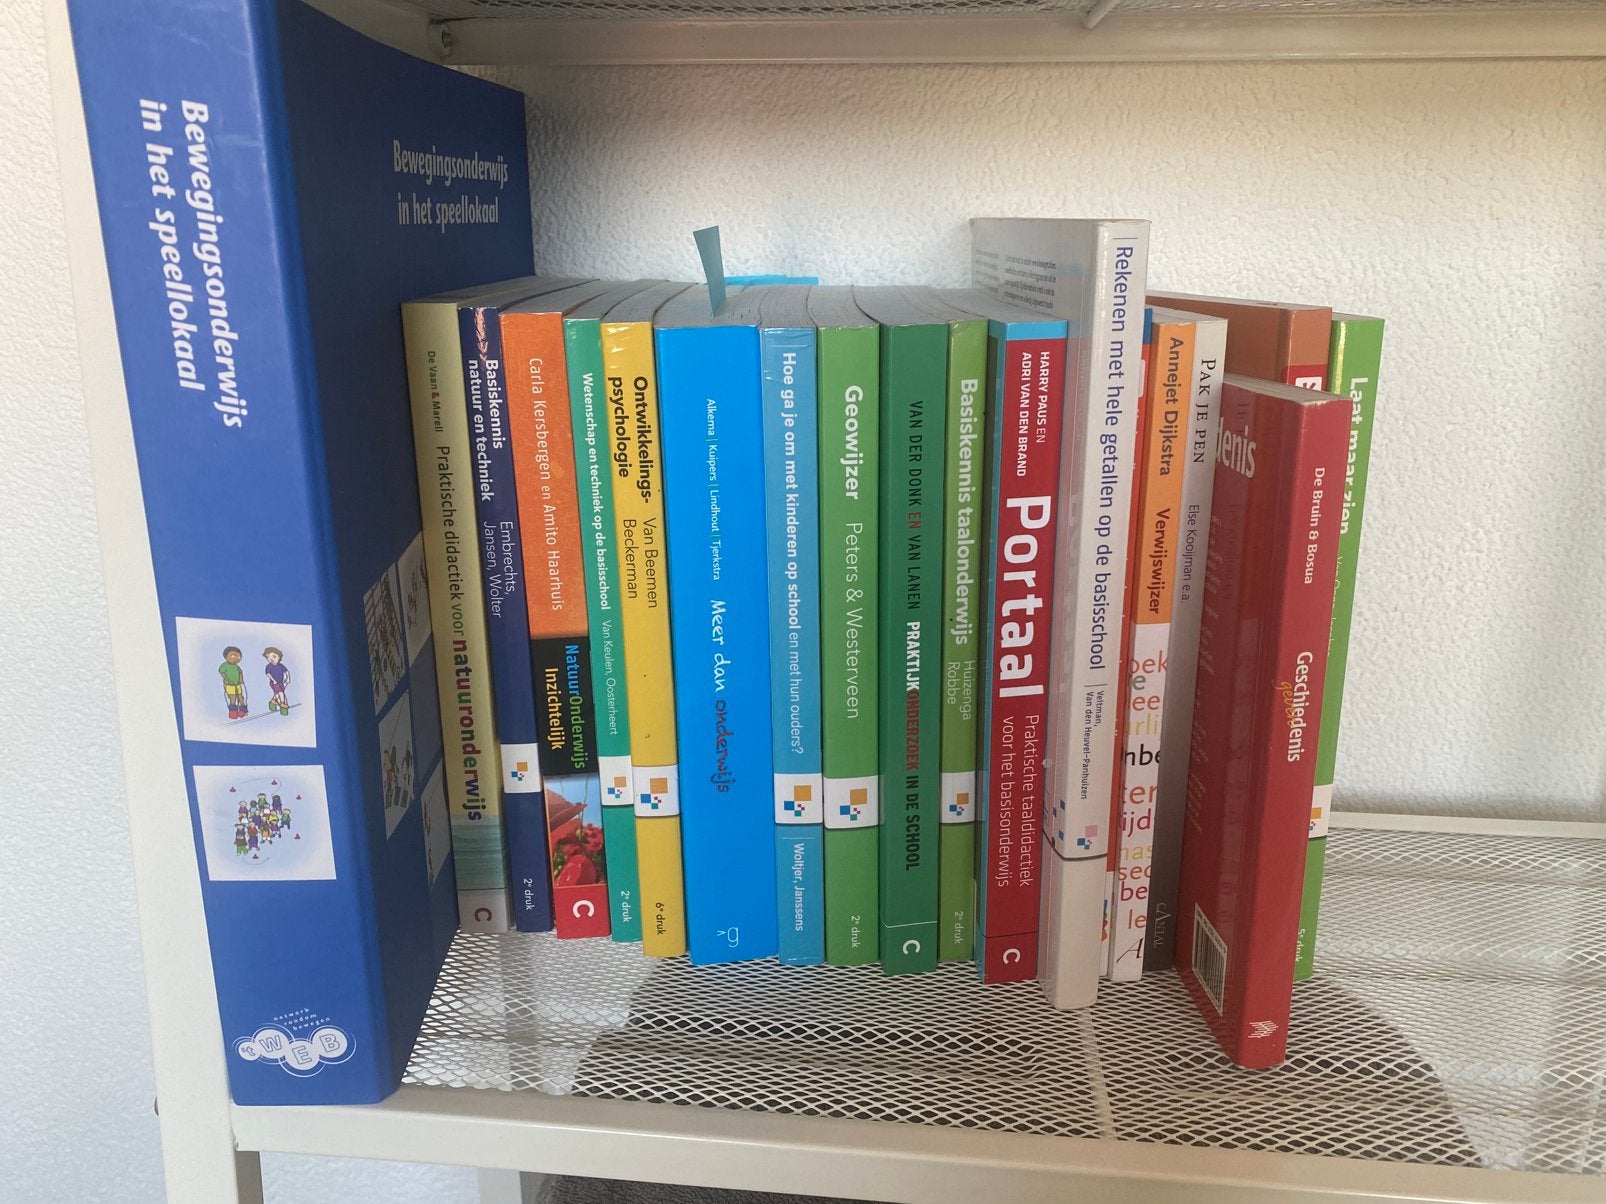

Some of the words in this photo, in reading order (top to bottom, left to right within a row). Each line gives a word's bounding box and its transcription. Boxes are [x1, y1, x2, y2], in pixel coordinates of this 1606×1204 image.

[140, 98, 167, 132] in
[146, 143, 174, 199] het
[393, 139, 508, 189] Bewegingsonderwijs
[398, 193, 409, 224] in
[412, 194, 432, 225] het
[436, 196, 498, 232] speellokaal
[182, 99, 242, 428] Bewegingsonderwijs
[149, 209, 205, 391] speellokaal
[1112, 247, 1133, 332] Rekenen
[428, 351, 435, 363] De
[529, 358, 544, 394] Carla
[783, 353, 796, 385] Hoe
[1021, 352, 1032, 378] ADRI
[1039, 352, 1050, 392] HARRY
[1109, 340, 1124, 379] met
[1163, 337, 1184, 405] Annejet
[430, 367, 438, 389] Vaan
[469, 360, 483, 410] natuur
[1020, 381, 1031, 408] VAN
[1200, 359, 1216, 397] PAK
[432, 401, 443, 432] Marell
[486, 360, 506, 449] Basiskennis
[583, 373, 597, 445] Wetenschap
[707, 399, 717, 436] Alkema
[781, 389, 794, 409] ga
[910, 401, 923, 428] VAN
[1037, 395, 1048, 425] PAUS
[1105, 386, 1124, 426] hele
[1196, 403, 1209, 421] JE
[474, 416, 483, 432] en
[608, 377, 632, 478] psychologie
[781, 412, 798, 427] je
[1019, 411, 1030, 434] DEN
[1036, 428, 1046, 443] EN
[533, 400, 551, 480] Kersbergen
[589, 448, 596, 462] en
[633, 376, 653, 503] Ontwikkelings-
[784, 434, 795, 455] om
[840, 385, 864, 500] Geowijzer
[910, 435, 922, 462] DER
[958, 379, 978, 503] Basiskennis
[1017, 437, 1027, 477] BRAND
[1159, 410, 1179, 476] Dijkstra
[1193, 430, 1207, 463] PEN
[476, 436, 494, 501] techniek
[706, 444, 719, 481] Kuipers
[785, 461, 798, 489] met
[1100, 433, 1119, 508] getallen
[1314, 467, 1325, 486] De
[437, 446, 456, 527] Praktische
[541, 486, 551, 500] en
[590, 464, 602, 513] techniek
[909, 469, 922, 507] DONK
[543, 505, 559, 545] Amito
[592, 515, 602, 529] op
[709, 489, 721, 532] Lindhout
[786, 494, 799, 558] kinderen
[908, 512, 921, 528] EN
[1095, 515, 1112, 537] op
[1188, 505, 1199, 525] Else
[1310, 490, 1323, 527] Bruin
[484, 521, 496, 570] Jansen,
[595, 532, 604, 546] de
[643, 518, 656, 545] Van
[908, 535, 921, 561] VAN
[1309, 530, 1319, 541] &
[445, 531, 464, 600] didactiek
[500, 521, 519, 594] Embrechts,
[623, 519, 639, 599] Beckerman
[710, 539, 722, 580] Tjerkstra
[785, 563, 798, 580] op
[845, 523, 863, 582] Peters
[1097, 544, 1112, 566] de
[1149, 508, 1170, 614] Verwijswijzer
[1181, 529, 1197, 581] Kooijman
[1304, 544, 1318, 584] Bosua
[547, 550, 565, 611] Haarhuis
[597, 549, 611, 610] basisschool
[645, 550, 659, 608] Beemen
[907, 567, 920, 609] LANEN
[950, 506, 975, 645] taalonderwijs
[489, 574, 503, 618] Wolter
[788, 584, 801, 629] school
[847, 589, 863, 602] &
[999, 495, 1051, 697] Portaal
[451, 603, 464, 636] voor
[602, 620, 611, 637] Van
[711, 600, 726, 645] Meer
[1090, 572, 1112, 670] basisschool
[604, 640, 615, 675] Keulen,
[789, 633, 799, 648] en
[714, 653, 731, 692] dan
[790, 651, 801, 677] met
[847, 607, 863, 718] Westerveen
[790, 679, 801, 702] hun
[906, 622, 920, 770] PRAKTIJKONDERZOEK
[948, 662, 961, 705] Robbe
[960, 660, 975, 720] Huizenga
[1086, 692, 1094, 707] Van
[545, 667, 567, 750] Inzichtelijk
[565, 644, 588, 769] NatuurOnderwijs
[606, 678, 617, 735] Oosterheert
[1085, 709, 1093, 724] den
[1095, 691, 1105, 726] Veltman,
[1288, 652, 1313, 762] Geschiedenis
[453, 640, 487, 821] natuuronderwijs
[710, 700, 736, 793] onderwijs
[790, 705, 804, 754] ouders?
[1002, 716, 1013, 751] voor
[1001, 754, 1016, 777] het
[1023, 715, 1039, 791] Praktische
[1081, 727, 1092, 800] Heuvel-Panhuizen
[906, 776, 919, 789] IN
[906, 793, 919, 810] DE
[906, 815, 920, 871] SCHOOL
[998, 782, 1016, 887] basisonderwijs
[1019, 793, 1037, 887] taaldidactiek
[793, 843, 804, 883] Woltjer,
[474, 907, 492, 922] C
[525, 890, 535, 910] druk
[573, 900, 595, 918] C
[622, 903, 632, 923] druk
[793, 885, 804, 931] Janssens
[656, 914, 666, 935] druk
[852, 927, 861, 948] druk
[955, 923, 964, 944] druk
[903, 940, 921, 955] C
[1002, 949, 1021, 965] C
